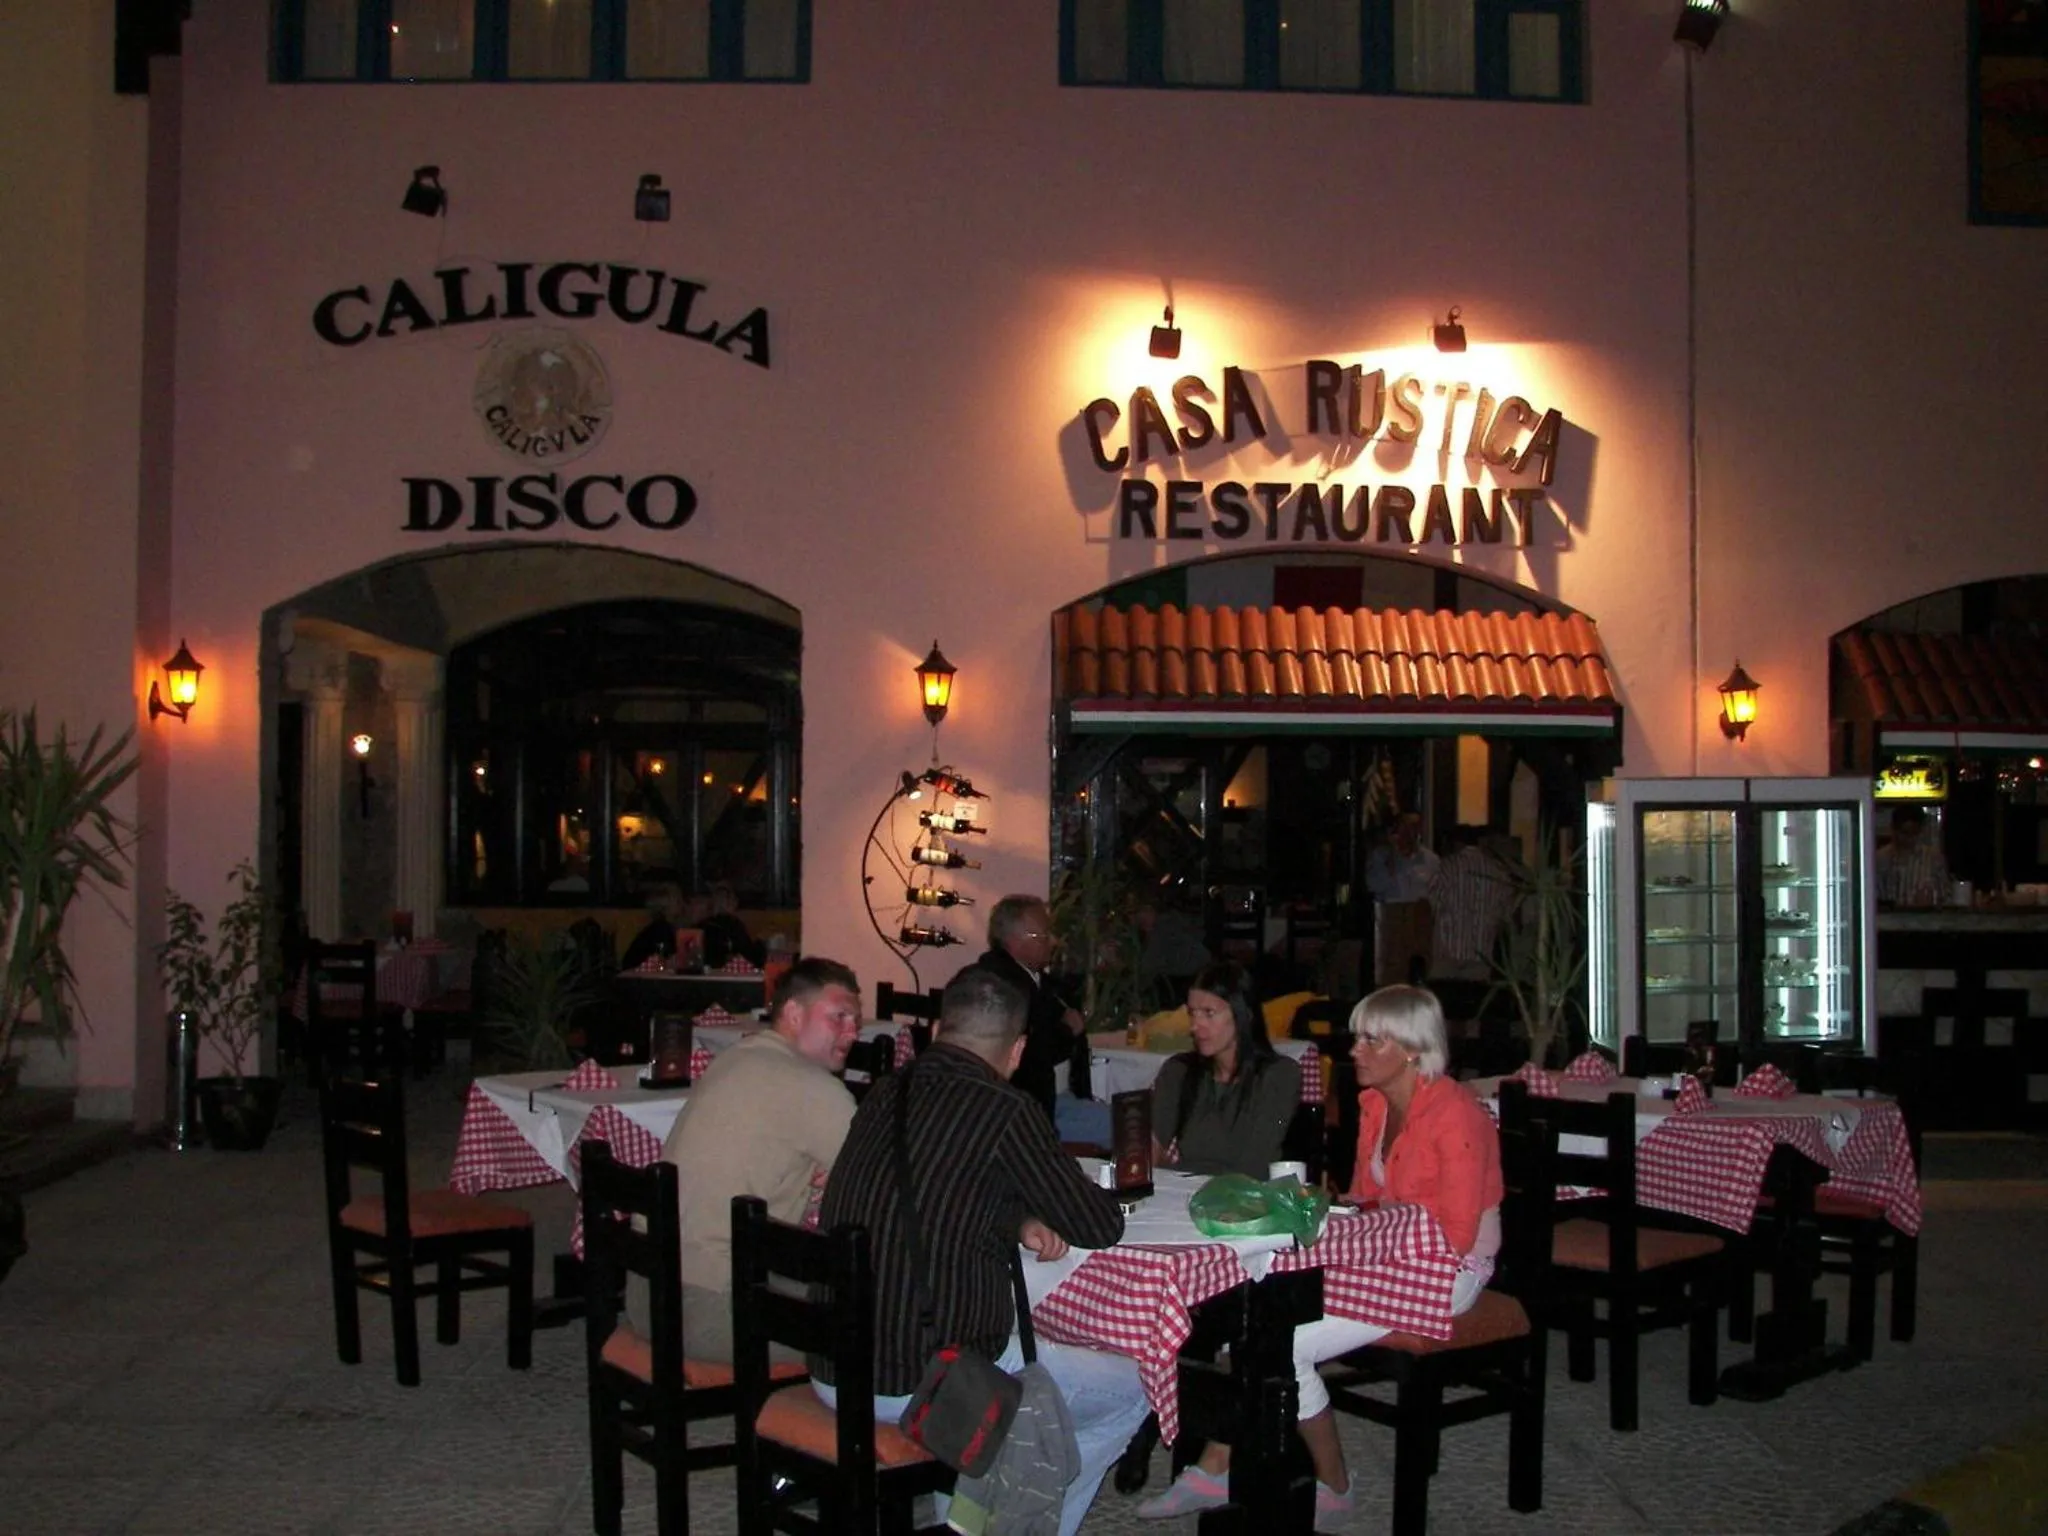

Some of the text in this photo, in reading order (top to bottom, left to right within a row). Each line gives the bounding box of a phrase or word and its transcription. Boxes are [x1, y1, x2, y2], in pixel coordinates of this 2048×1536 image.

[313, 262, 770, 369] CALIGULA
[486, 405, 601, 457] CALIGVLA
[1084, 359, 1564, 486] CASA RUSTICA
[401, 473, 698, 532] DISCO
[1119, 478, 1546, 546] RESTAURANT
